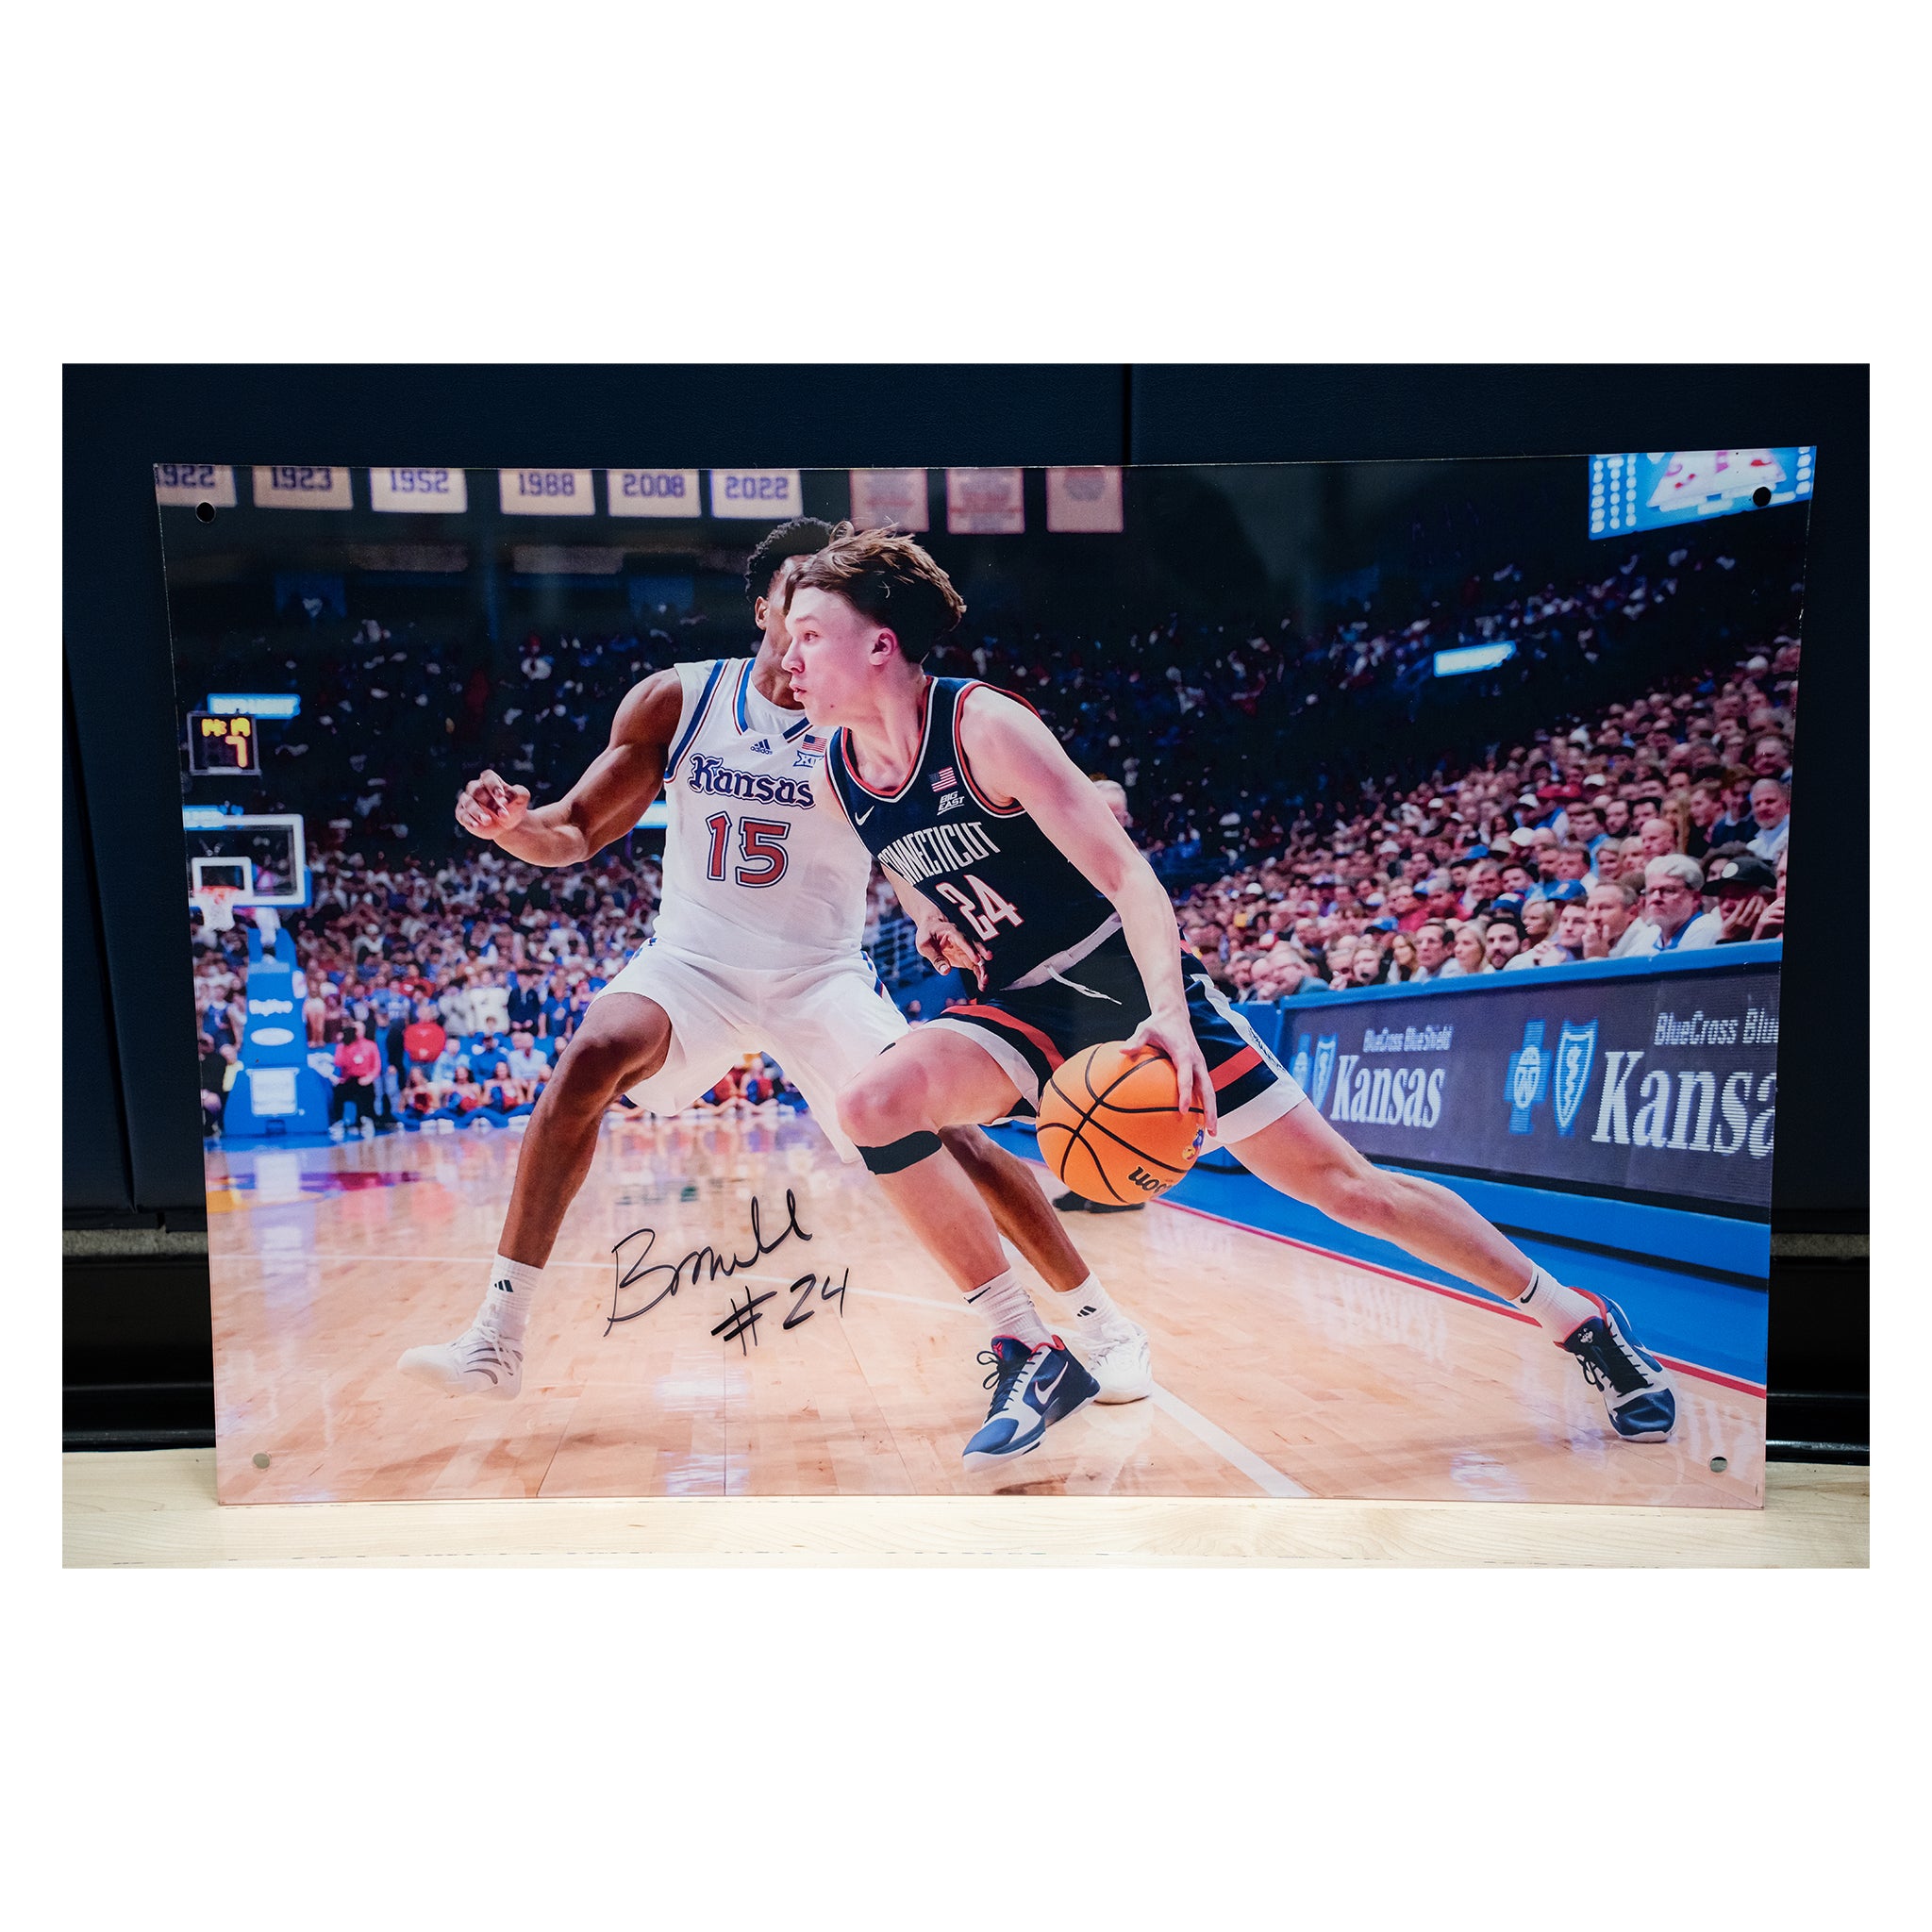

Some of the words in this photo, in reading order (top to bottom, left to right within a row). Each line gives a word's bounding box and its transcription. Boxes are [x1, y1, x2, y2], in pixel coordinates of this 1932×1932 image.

[272, 467, 332, 491] 1923
[390, 469, 449, 493] 1952
[519, 472, 575, 496] 1988
[623, 473, 686, 498] 2008
[724, 475, 789, 500] 2022
[688, 753, 816, 809] Kansas
[938, 795, 965, 812] EAST
[941, 791, 958, 803] BIG
[705, 810, 791, 889] 15
[935, 874, 1025, 941] 24
[1654, 1010, 1739, 1045] BlueCross
[1329, 1055, 1446, 1128] Kansas
